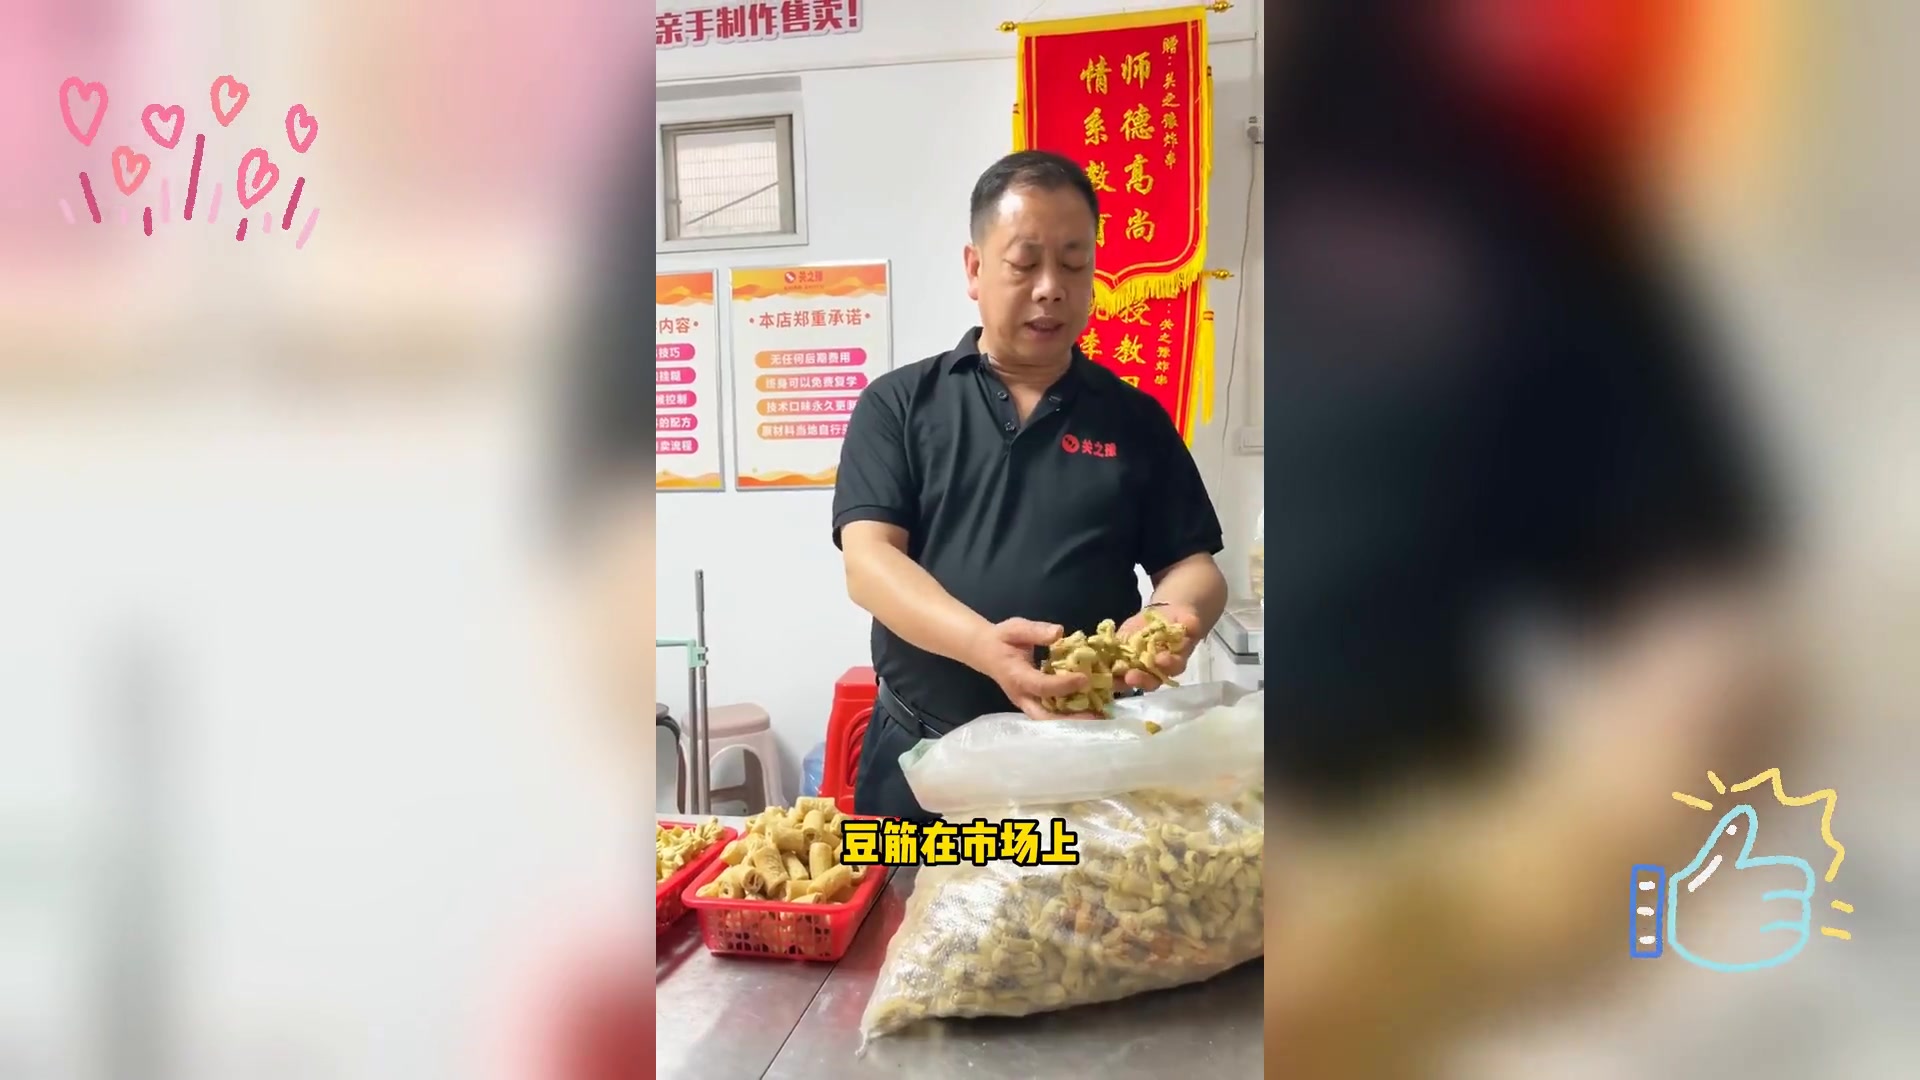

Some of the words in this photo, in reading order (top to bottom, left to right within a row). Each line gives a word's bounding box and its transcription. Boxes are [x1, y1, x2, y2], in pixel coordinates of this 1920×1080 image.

[1120, 51, 1156, 243] 师德高尚
[656, 317, 691, 334] 内容
[759, 308, 862, 329] 本店郑重承诺
[656, 346, 681, 359] 技巧
[770, 351, 851, 365] 无任何后期费用
[656, 370, 682, 382] 挂糊
[766, 375, 858, 389] 终身可以免费复学
[656, 417, 692, 429] 的配方
[656, 440, 693, 452] 卖流程
